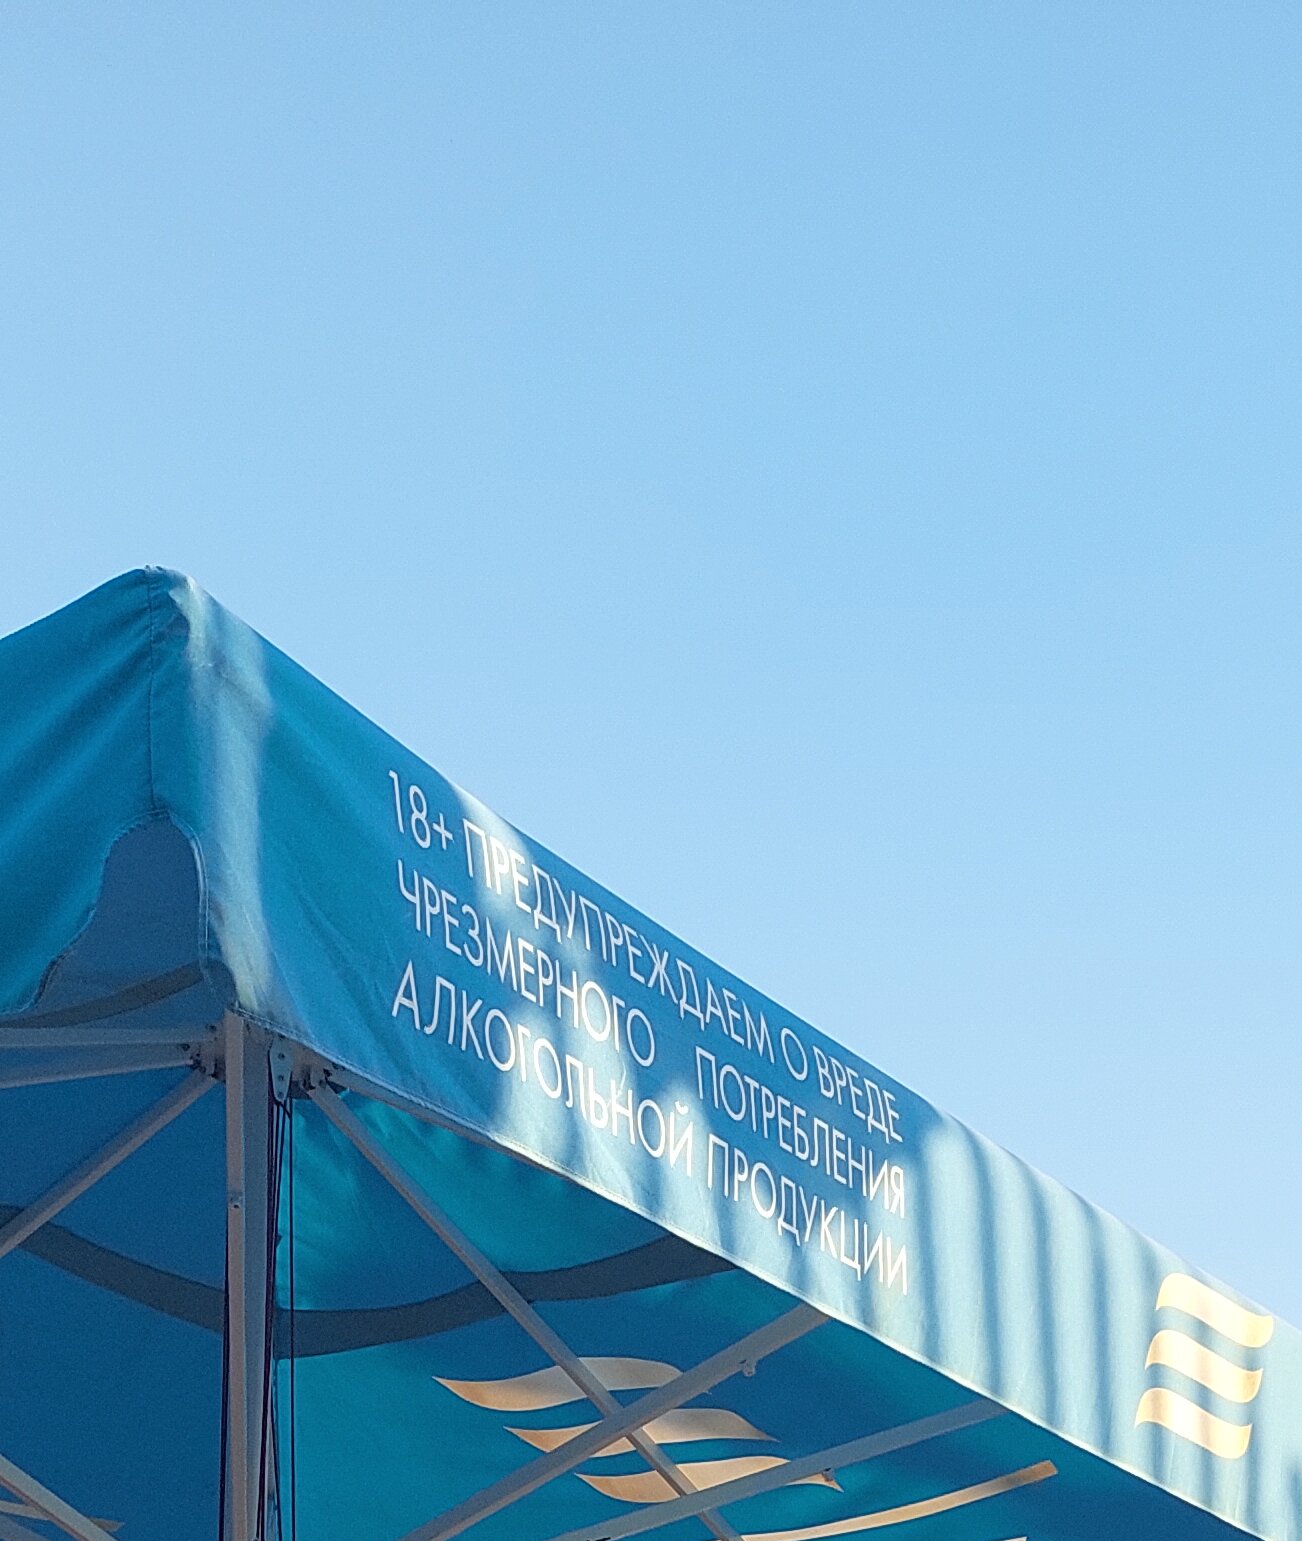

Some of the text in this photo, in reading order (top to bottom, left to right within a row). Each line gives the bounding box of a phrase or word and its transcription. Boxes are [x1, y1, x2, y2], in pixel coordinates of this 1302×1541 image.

[388, 769, 904, 1144] 18+ ПРЕДУПРЕЖДАЕМ О ВРЕДЕ
[391, 959, 909, 1297] АЛКОГОЛЬНОЙ ПРОДУКЦИИ
[397, 857, 906, 1220] ЧРЕЗМЕРНОГО ПОТРЕБЛЕНИЯ
